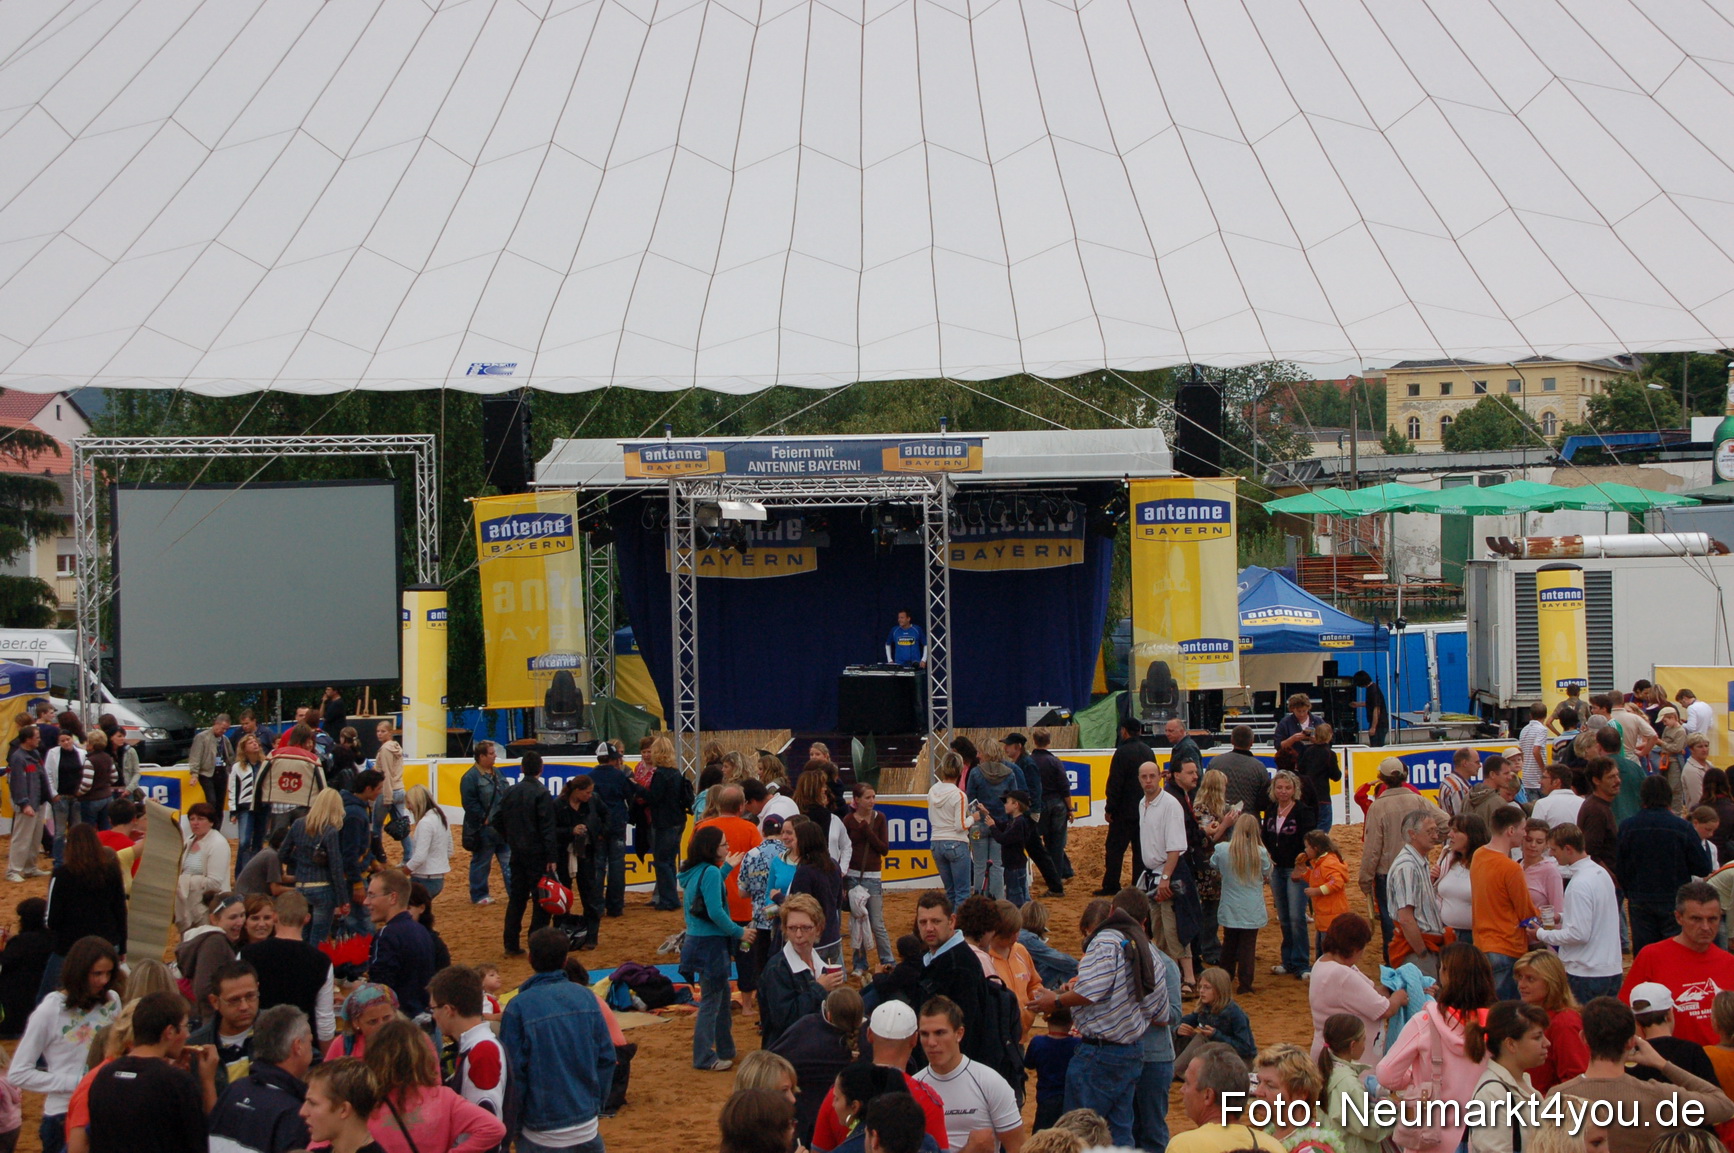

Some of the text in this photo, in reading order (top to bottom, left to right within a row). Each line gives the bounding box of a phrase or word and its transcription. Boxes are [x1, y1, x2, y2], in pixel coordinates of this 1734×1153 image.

[645, 449, 701, 461] antenne
[771, 445, 834, 459] Feiern mit
[904, 444, 962, 456] antenne
[647, 463, 702, 471] BAYERN
[748, 460, 861, 473] ANTENNE BAYERN!
[1144, 504, 1223, 521] antenne
[488, 519, 566, 539] antenne
[1145, 526, 1223, 536] BAYERN
[490, 540, 567, 553] BAYERN
[951, 545, 1072, 562] BAYERN
[1541, 590, 1582, 600] antenne
[1248, 608, 1313, 619] antenne
[1182, 642, 1229, 652] antenne
[281, 777, 299, 788] 3C
